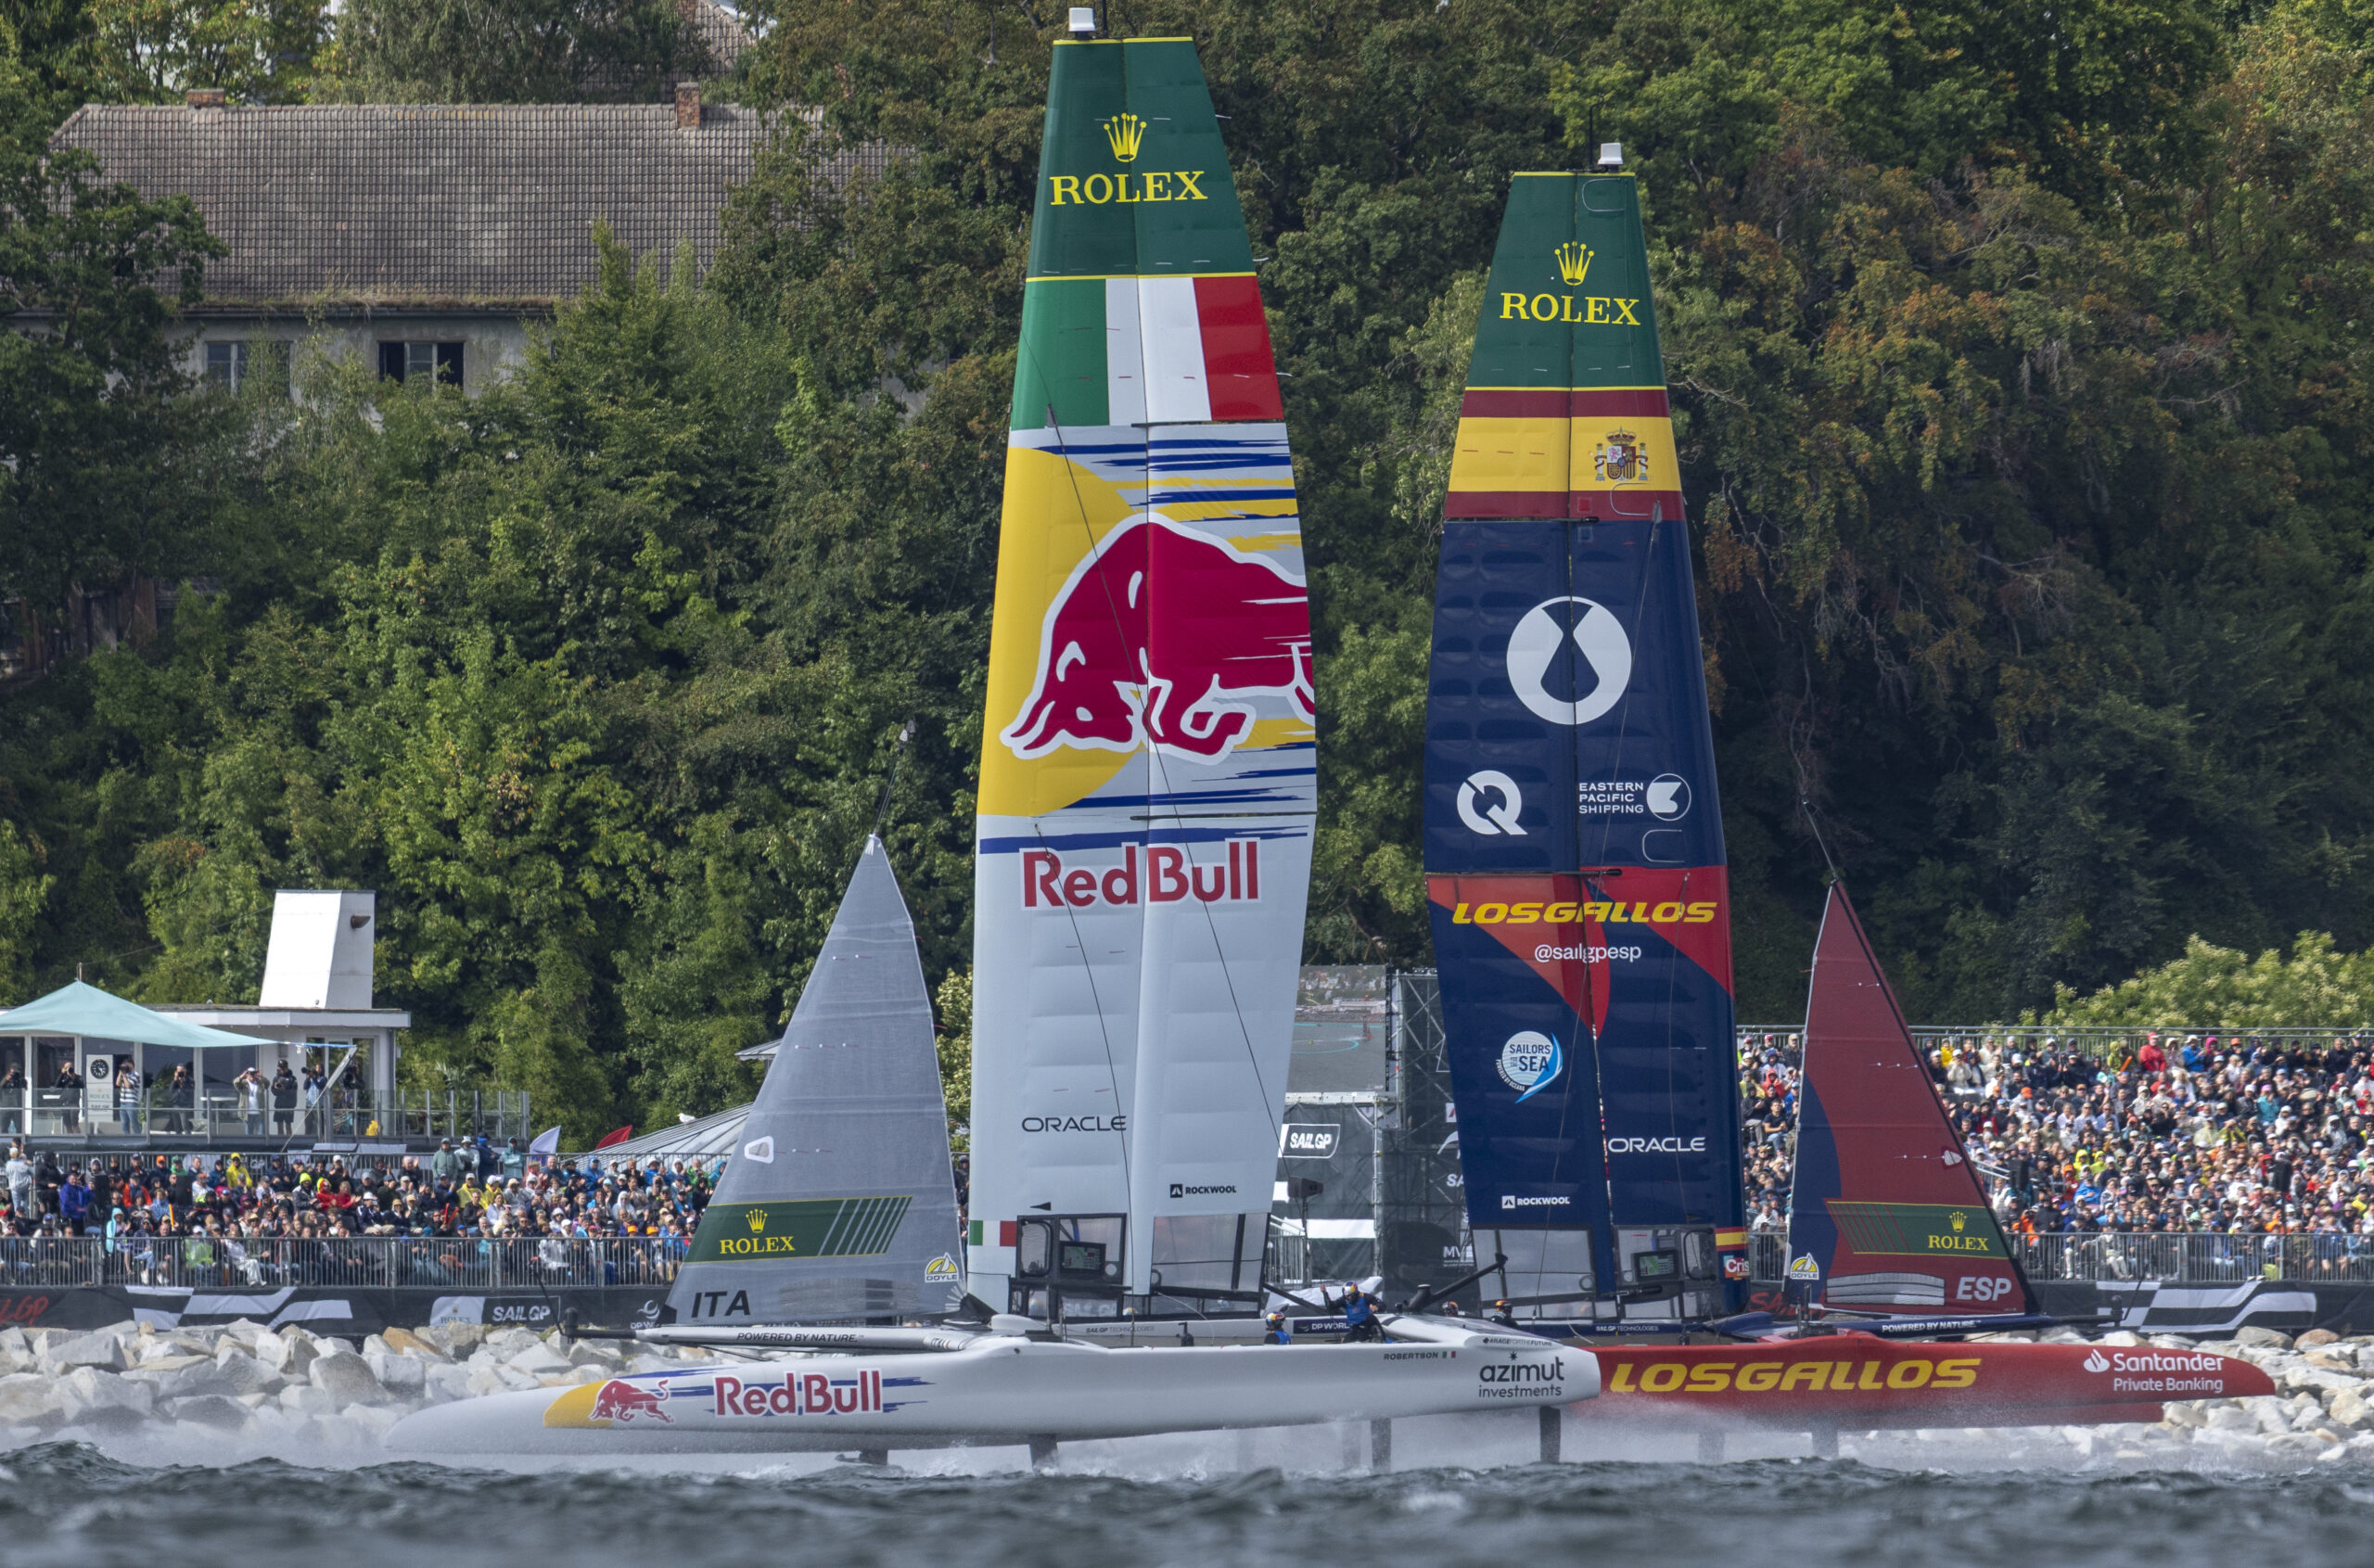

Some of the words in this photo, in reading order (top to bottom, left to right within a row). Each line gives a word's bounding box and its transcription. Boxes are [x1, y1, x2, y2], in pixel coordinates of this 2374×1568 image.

[1049, 170, 1208, 206] ROLEX
[1499, 291, 1641, 326] ROLEX
[1578, 782, 1644, 792] EASTERN
[1578, 793, 1635, 803] PACIFIC
[1578, 804, 1645, 815] SHIPPING
[1534, 943, 1642, 963] @sailgpesp
[1509, 1043, 1551, 1054] SAILORS
[1518, 1055, 1550, 1072] SEA
[1021, 1115, 1128, 1132] ORACLE
[1607, 1136, 1706, 1154] ORACLE
[1184, 1184, 1237, 1195] ROCKWOOL
[1516, 1196, 1571, 1205] ROCKWOOL
[719, 1235, 796, 1255] ROLEX
[1928, 1234, 1989, 1252] ROLEX
[1955, 1276, 2012, 1302] ESP
[691, 1289, 751, 1319] ITA
[1311, 1322, 1324, 1331] DP
[1324, 1321, 1352, 1330] WORL
[1882, 1322, 1926, 1333] POWERED
[1926, 1321, 1939, 1332] BY
[736, 1332, 793, 1343] POWERED
[794, 1332, 810, 1343] BY
[1383, 1351, 1439, 1361] ROBERTSON
[2112, 1351, 2226, 1372] Santander
[1479, 1354, 1564, 1383] azimut
[1478, 1383, 1563, 1398] investments
[2113, 1376, 2164, 1392] Private
[2165, 1376, 2224, 1395] Banking
